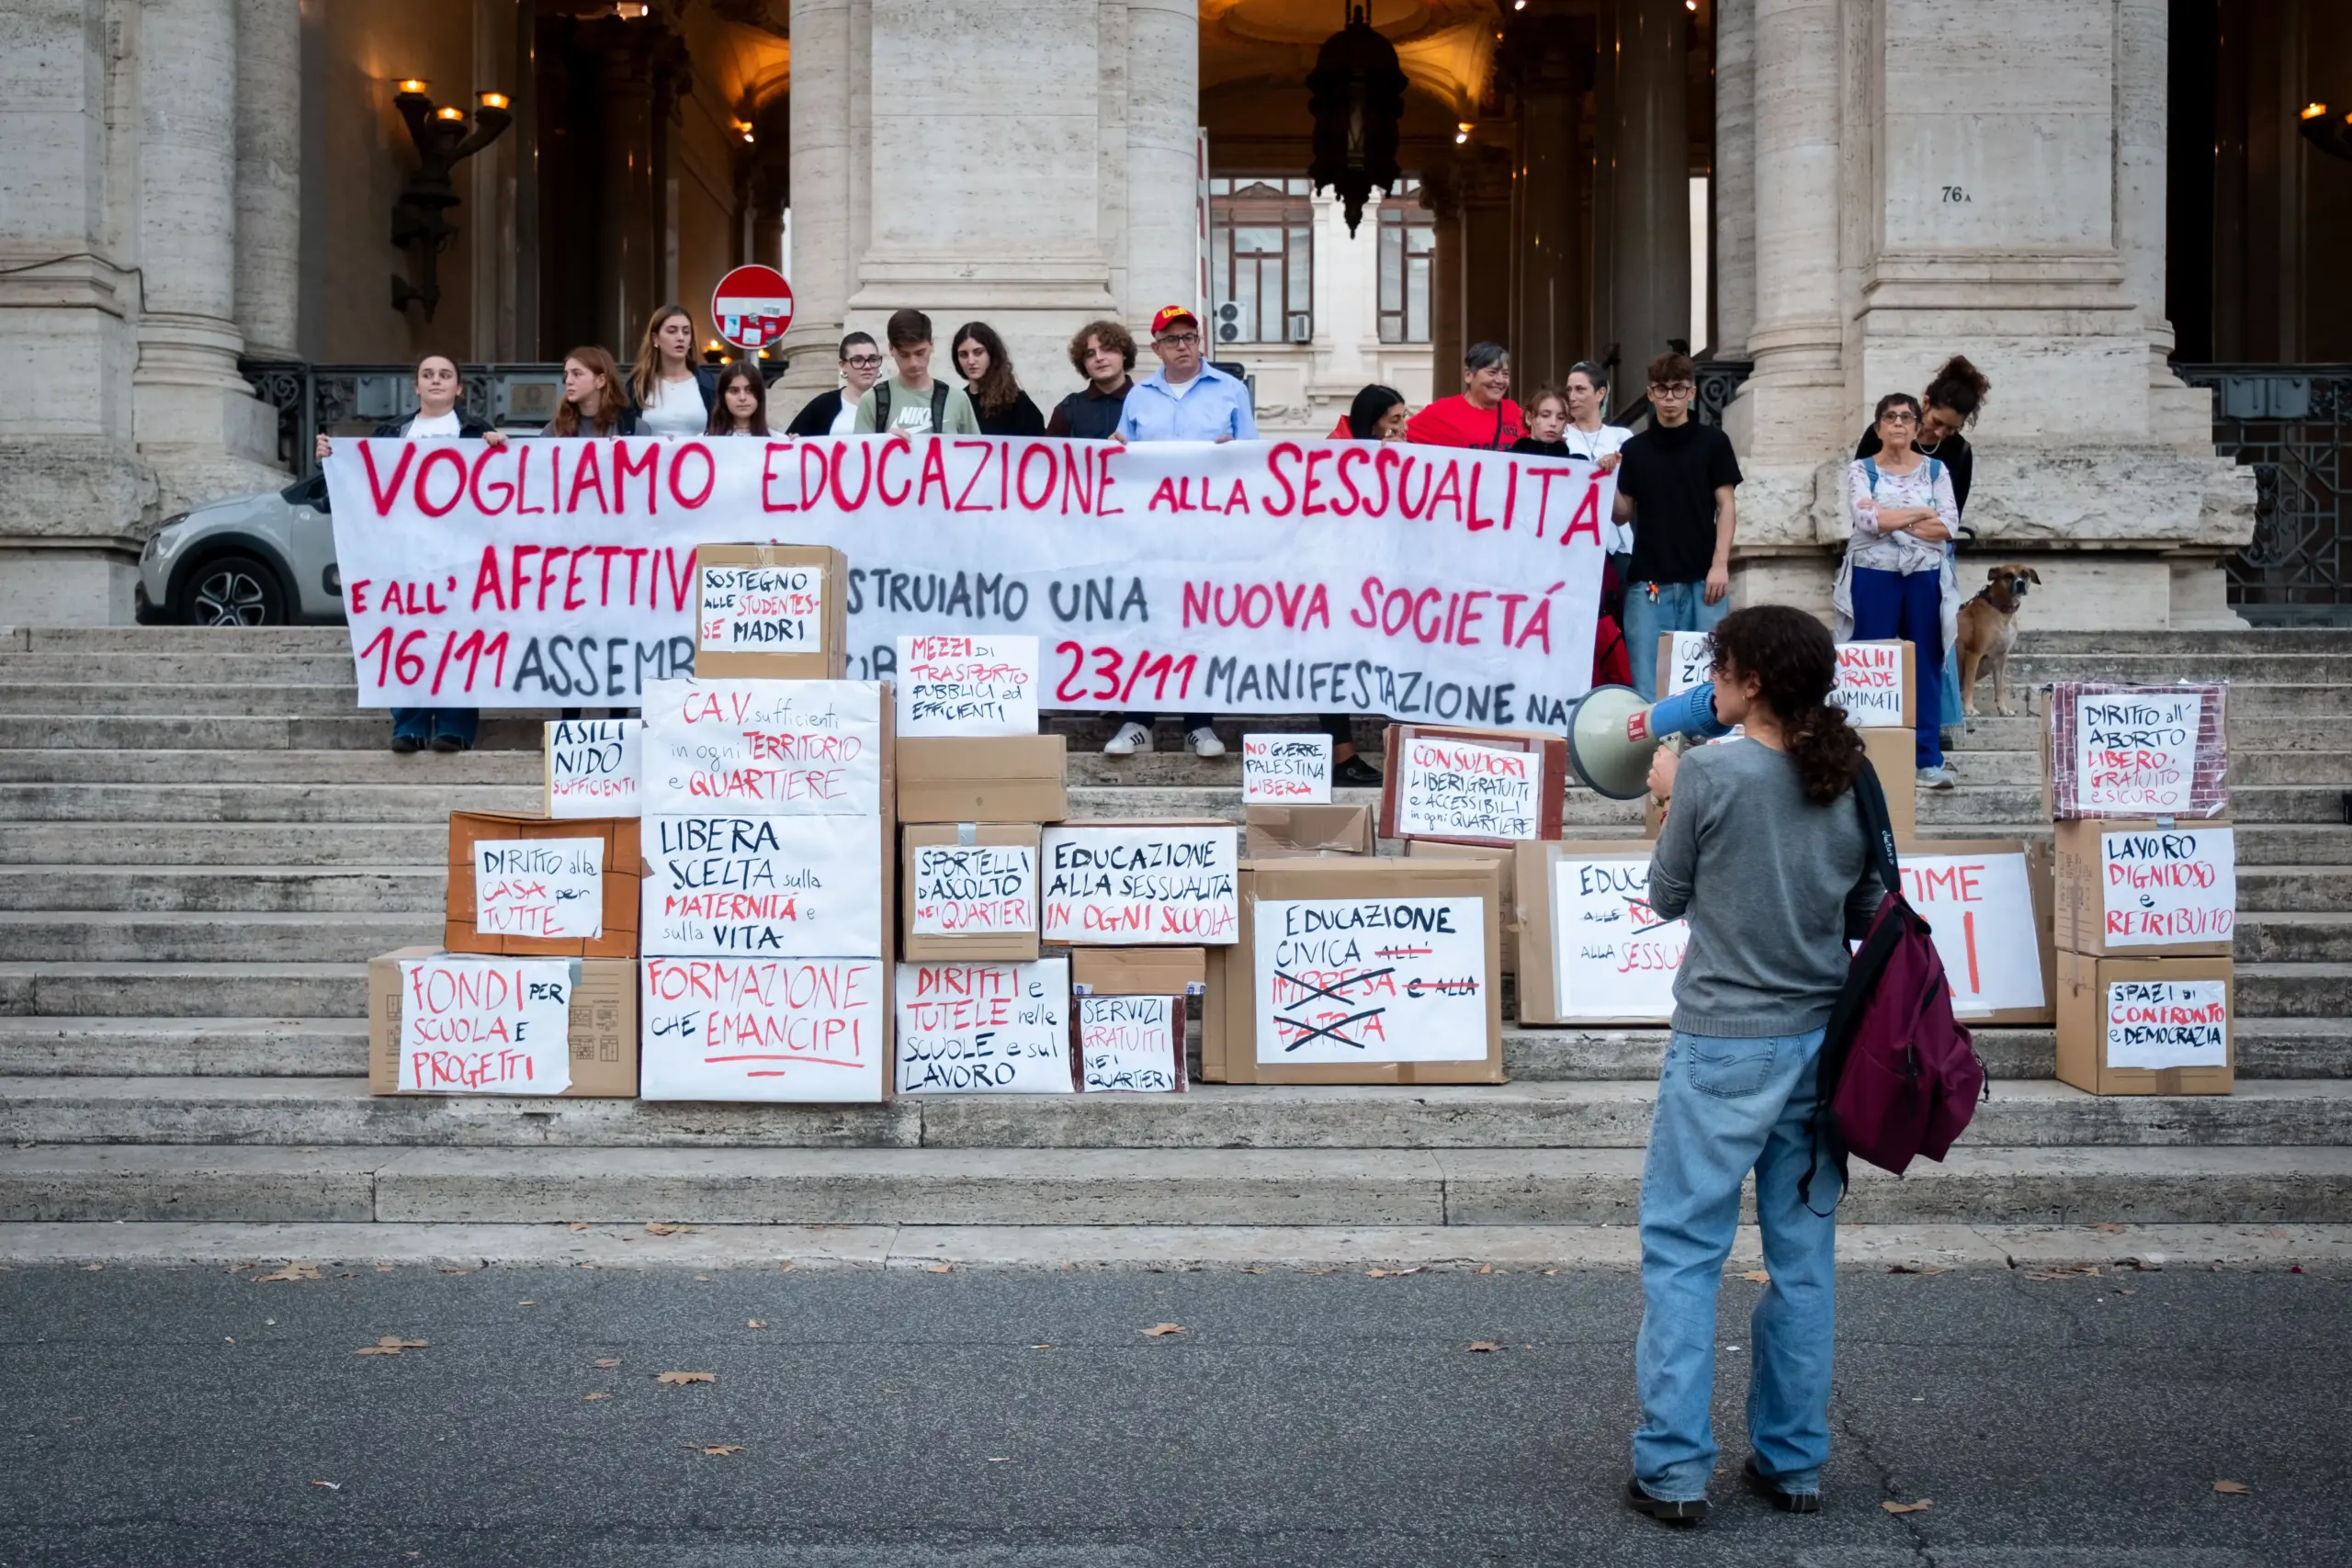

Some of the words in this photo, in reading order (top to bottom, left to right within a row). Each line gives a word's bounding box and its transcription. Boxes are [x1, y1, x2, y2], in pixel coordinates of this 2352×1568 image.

[358, 439, 715, 517] VOGLIAMO
[763, 435, 1125, 516] EDUCAZIONE
[1149, 476, 1250, 516] ALLA
[351, 579, 370, 615] E
[380, 575, 457, 615] ALL'
[471, 544, 696, 613] AFFETTIV
[705, 570, 808, 592] SOSTEGNO
[704, 593, 736, 609] ALLE
[847, 568, 1029, 622] STRUIAMO
[1049, 577, 1149, 624] UNA
[1182, 581, 1329, 632] NUOVA
[704, 618, 726, 639] SE
[732, 618, 805, 643] MADRI
[360, 626, 510, 696] 16/11
[513, 634, 695, 697] ASSEMB
[910, 636, 971, 660] MEZZI
[975, 647, 994, 657] DI
[910, 663, 1028, 684] TRASPORTO
[1056, 640, 1197, 705] 23/11
[1204, 655, 1515, 725] MANIFESTAZIONE
[912, 682, 995, 700] PUBBLICI
[1001, 686, 1023, 700] ed
[756, 697, 839, 729] sufficienti
[911, 701, 1005, 722] EFFICIENTI
[2084, 704, 2159, 727] DIRITTO
[553, 720, 624, 747] ASILI
[2088, 728, 2186, 750] ABORTO
[555, 742, 623, 774] NIDO
[672, 743, 688, 759] in
[696, 742, 741, 772] ogni
[742, 730, 862, 763] TERRITORIO
[1245, 742, 1267, 756] NO
[1271, 741, 1327, 761] GUERRE,
[1413, 744, 1525, 780] CONSULTORI
[1245, 759, 1325, 781] PALESTINA
[2091, 768, 2180, 789] GRATUITO
[553, 776, 636, 797] SUFFICIENTI
[669, 776, 684, 790] e
[689, 768, 848, 802] QUARTIERE
[1249, 778, 1311, 797] LIBERA
[2091, 791, 2103, 804] e
[2109, 788, 2178, 806] SICURO
[1410, 796, 1420, 806] e
[1426, 794, 1520, 815] ACCESSIBILI
[661, 818, 780, 854] LIBERA
[1411, 810, 1419, 819] in
[1424, 813, 1448, 830] ogni
[1451, 811, 1534, 836] QUARTIERE
[1055, 840, 1217, 871] EDUCAZIONE
[2108, 834, 2197, 860] LAVORO
[483, 848, 563, 874] DIRITTO
[569, 850, 598, 875] alla
[668, 857, 775, 890] SCELTA
[782, 868, 822, 889] sulla
[921, 849, 1030, 877] SPORTELLI
[2109, 860, 2216, 889] DIGNITOSO
[482, 879, 547, 902] CASA
[555, 886, 591, 905] per
[919, 874, 1022, 901] D'ASCOLTO
[1046, 873, 1112, 897] ALLA
[806, 908, 816, 920] e
[917, 905, 939, 921] NEI
[941, 898, 1032, 930] QUARTIERI
[2140, 893, 2155, 908] e
[483, 905, 565, 936] TUTTE
[1046, 902, 1072, 931] IN
[1083, 902, 1151, 932] OGNI
[1160, 904, 1237, 937] SCUOLA
[1285, 904, 1456, 937] EDUCAZIONE
[2107, 906, 2233, 937] RETRIBUITO
[662, 920, 705, 942] sulla
[713, 924, 785, 951] VITA
[1275, 936, 1362, 968] CIVICA
[1580, 943, 1616, 960] ALLA
[410, 965, 525, 1014] FONDI
[529, 983, 565, 1005] PER
[648, 959, 871, 1010] FORMAZIONE
[916, 966, 1019, 998] DIRITTI
[1029, 981, 1045, 998] e
[1272, 966, 1397, 1005] IMPRESA
[2113, 983, 2174, 1004] SPAZI
[2182, 989, 2196, 1000] DI
[906, 998, 1012, 1032] TUTELE
[1018, 1003, 1057, 1025] nelle
[1083, 998, 1163, 1024] SERVIZI
[2110, 1002, 2225, 1025] CONFRONTO
[413, 1015, 510, 1045] SCUOLA
[514, 1021, 530, 1043] E
[651, 1010, 701, 1038] CHE
[707, 1010, 860, 1056] EMANCIPI
[1082, 1024, 1165, 1053] GRATUITI
[2109, 1029, 2121, 1043] e
[2124, 1026, 2222, 1047] DEMOCRAZIA
[902, 1032, 996, 1062] SCUOLE
[1006, 1042, 1022, 1056] e
[1027, 1032, 1057, 1058] sul
[412, 1048, 534, 1089] PROGETTI
[905, 1062, 1016, 1091] LAVORO
[1085, 1055, 1118, 1070] NEI
[1086, 1069, 1174, 1089] QUARTIERI
